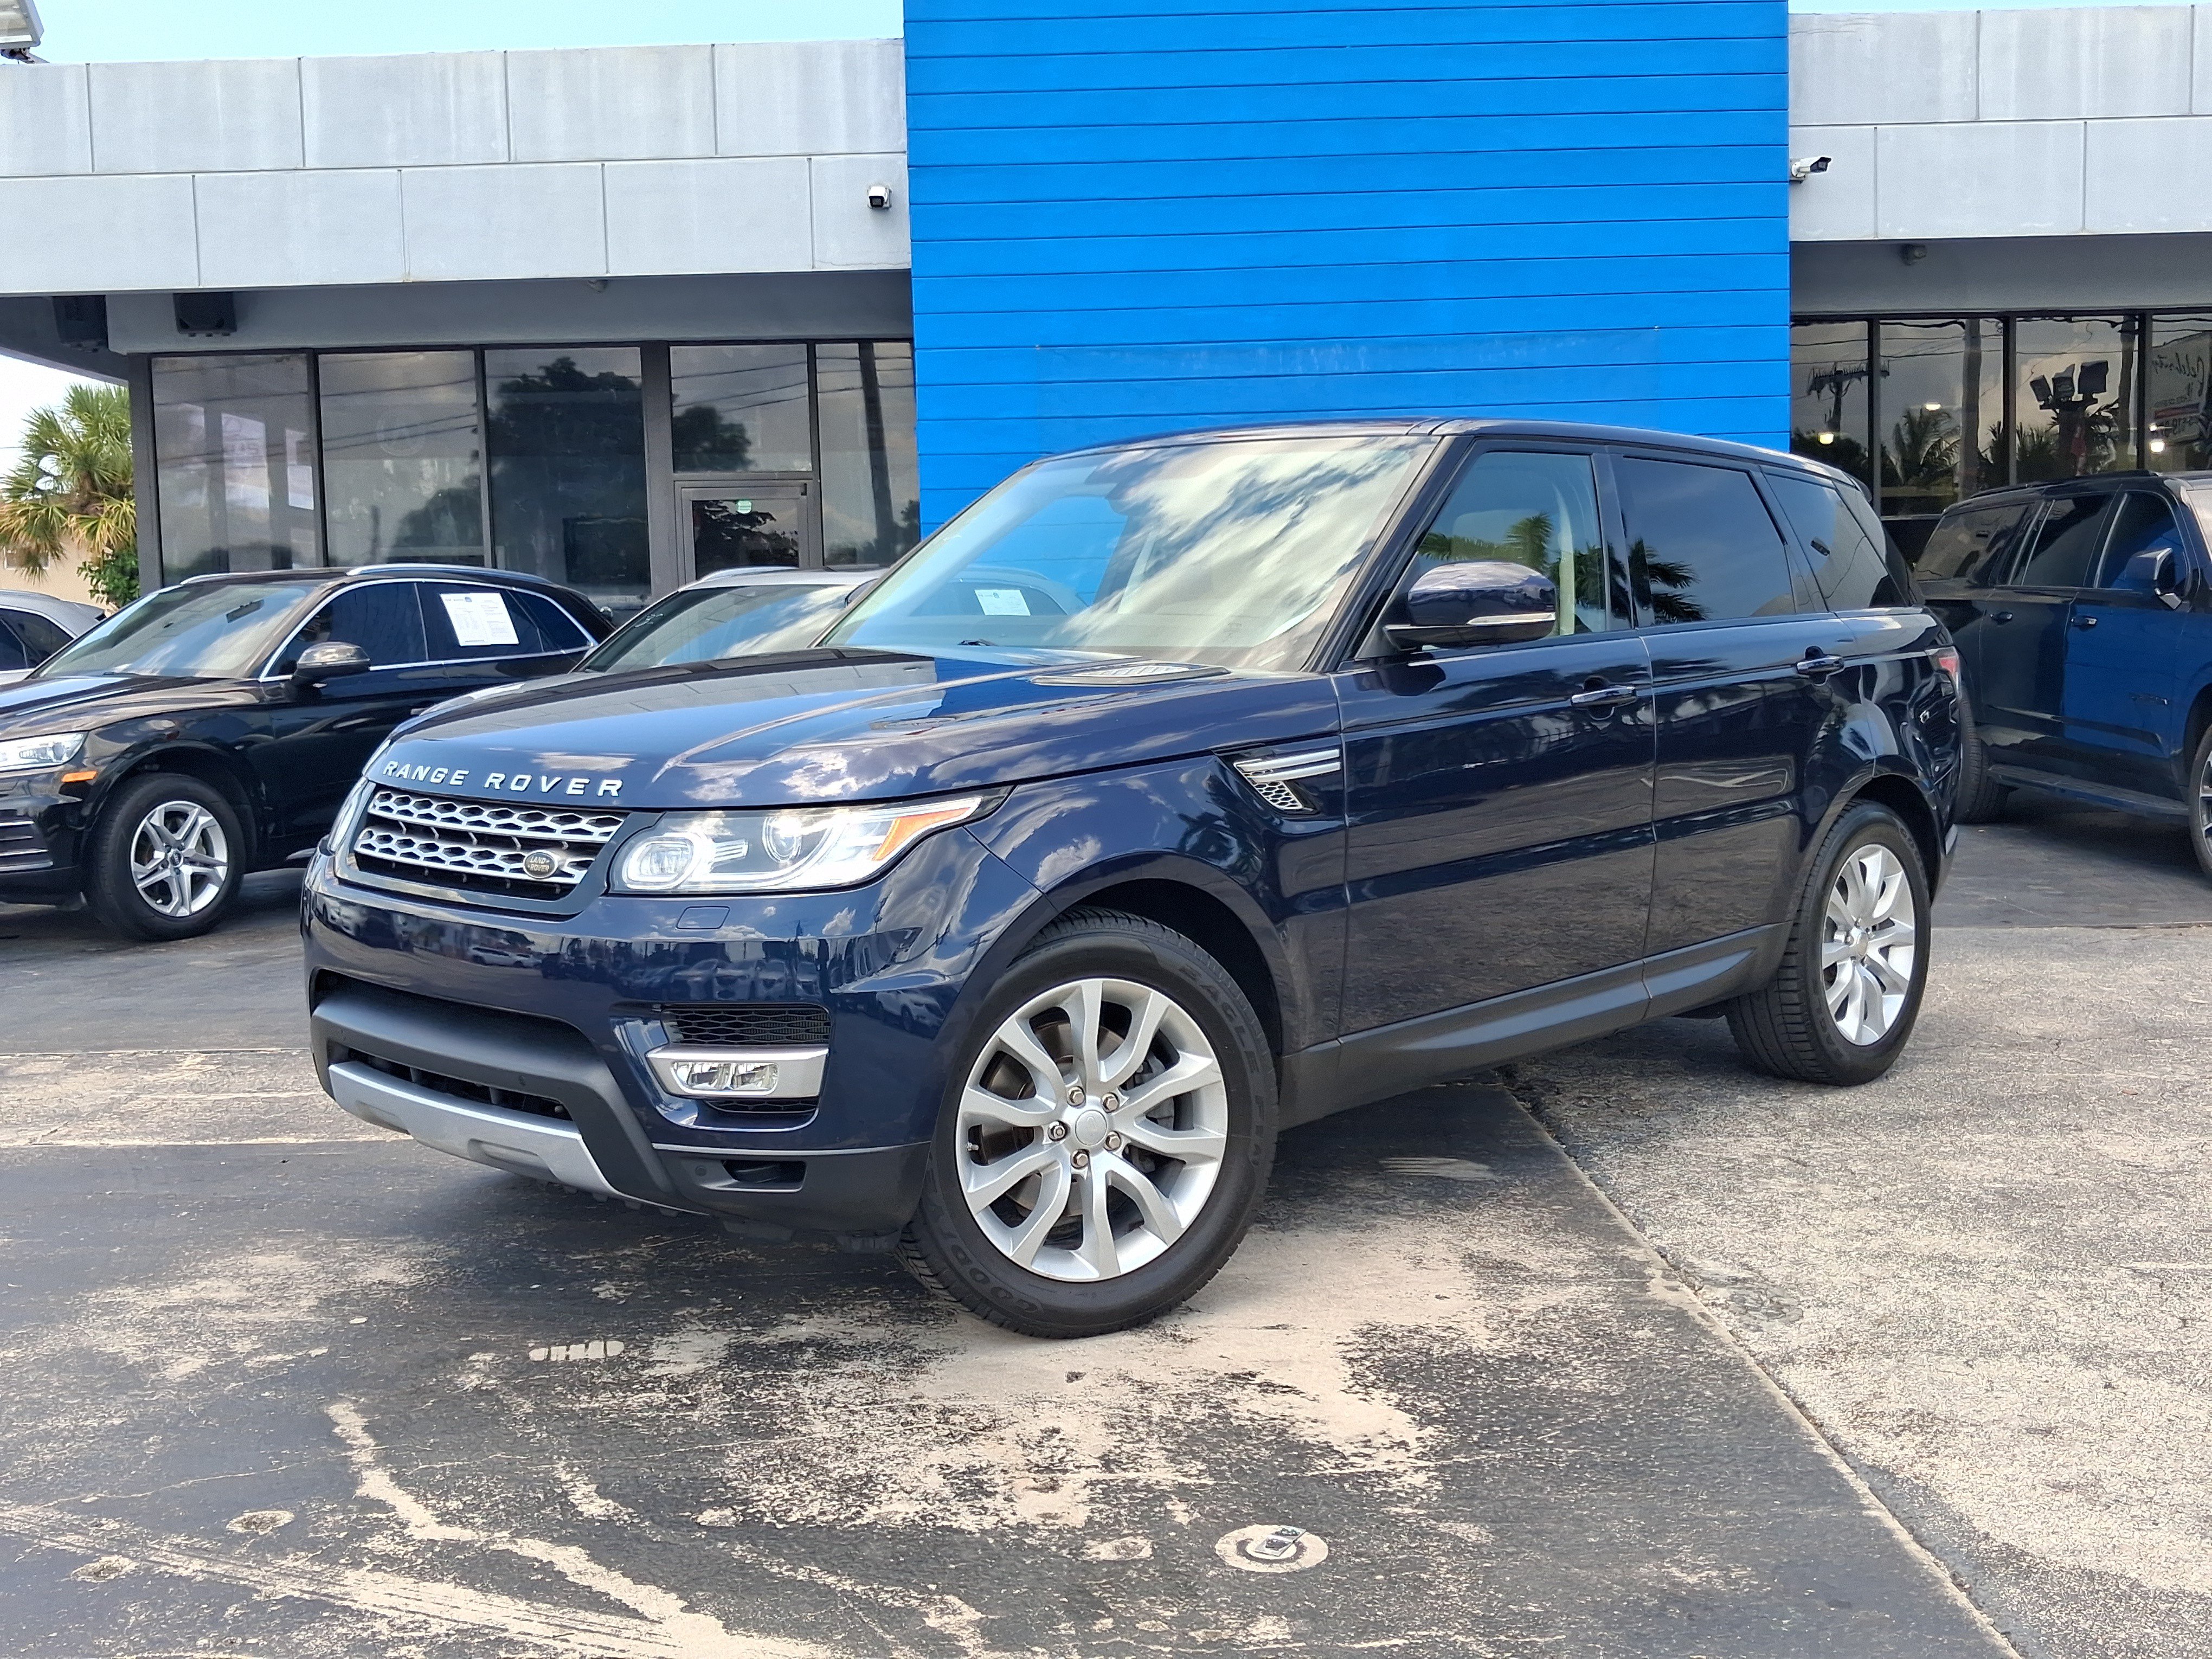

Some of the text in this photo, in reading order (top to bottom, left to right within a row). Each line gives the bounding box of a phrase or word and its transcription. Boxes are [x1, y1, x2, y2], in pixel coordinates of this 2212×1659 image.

[383, 761, 623, 796] RANGE ROVER
[529, 856, 546, 864] LAND
[530, 864, 550, 872] ROVER
[1179, 964, 1260, 1075] EAGLE
